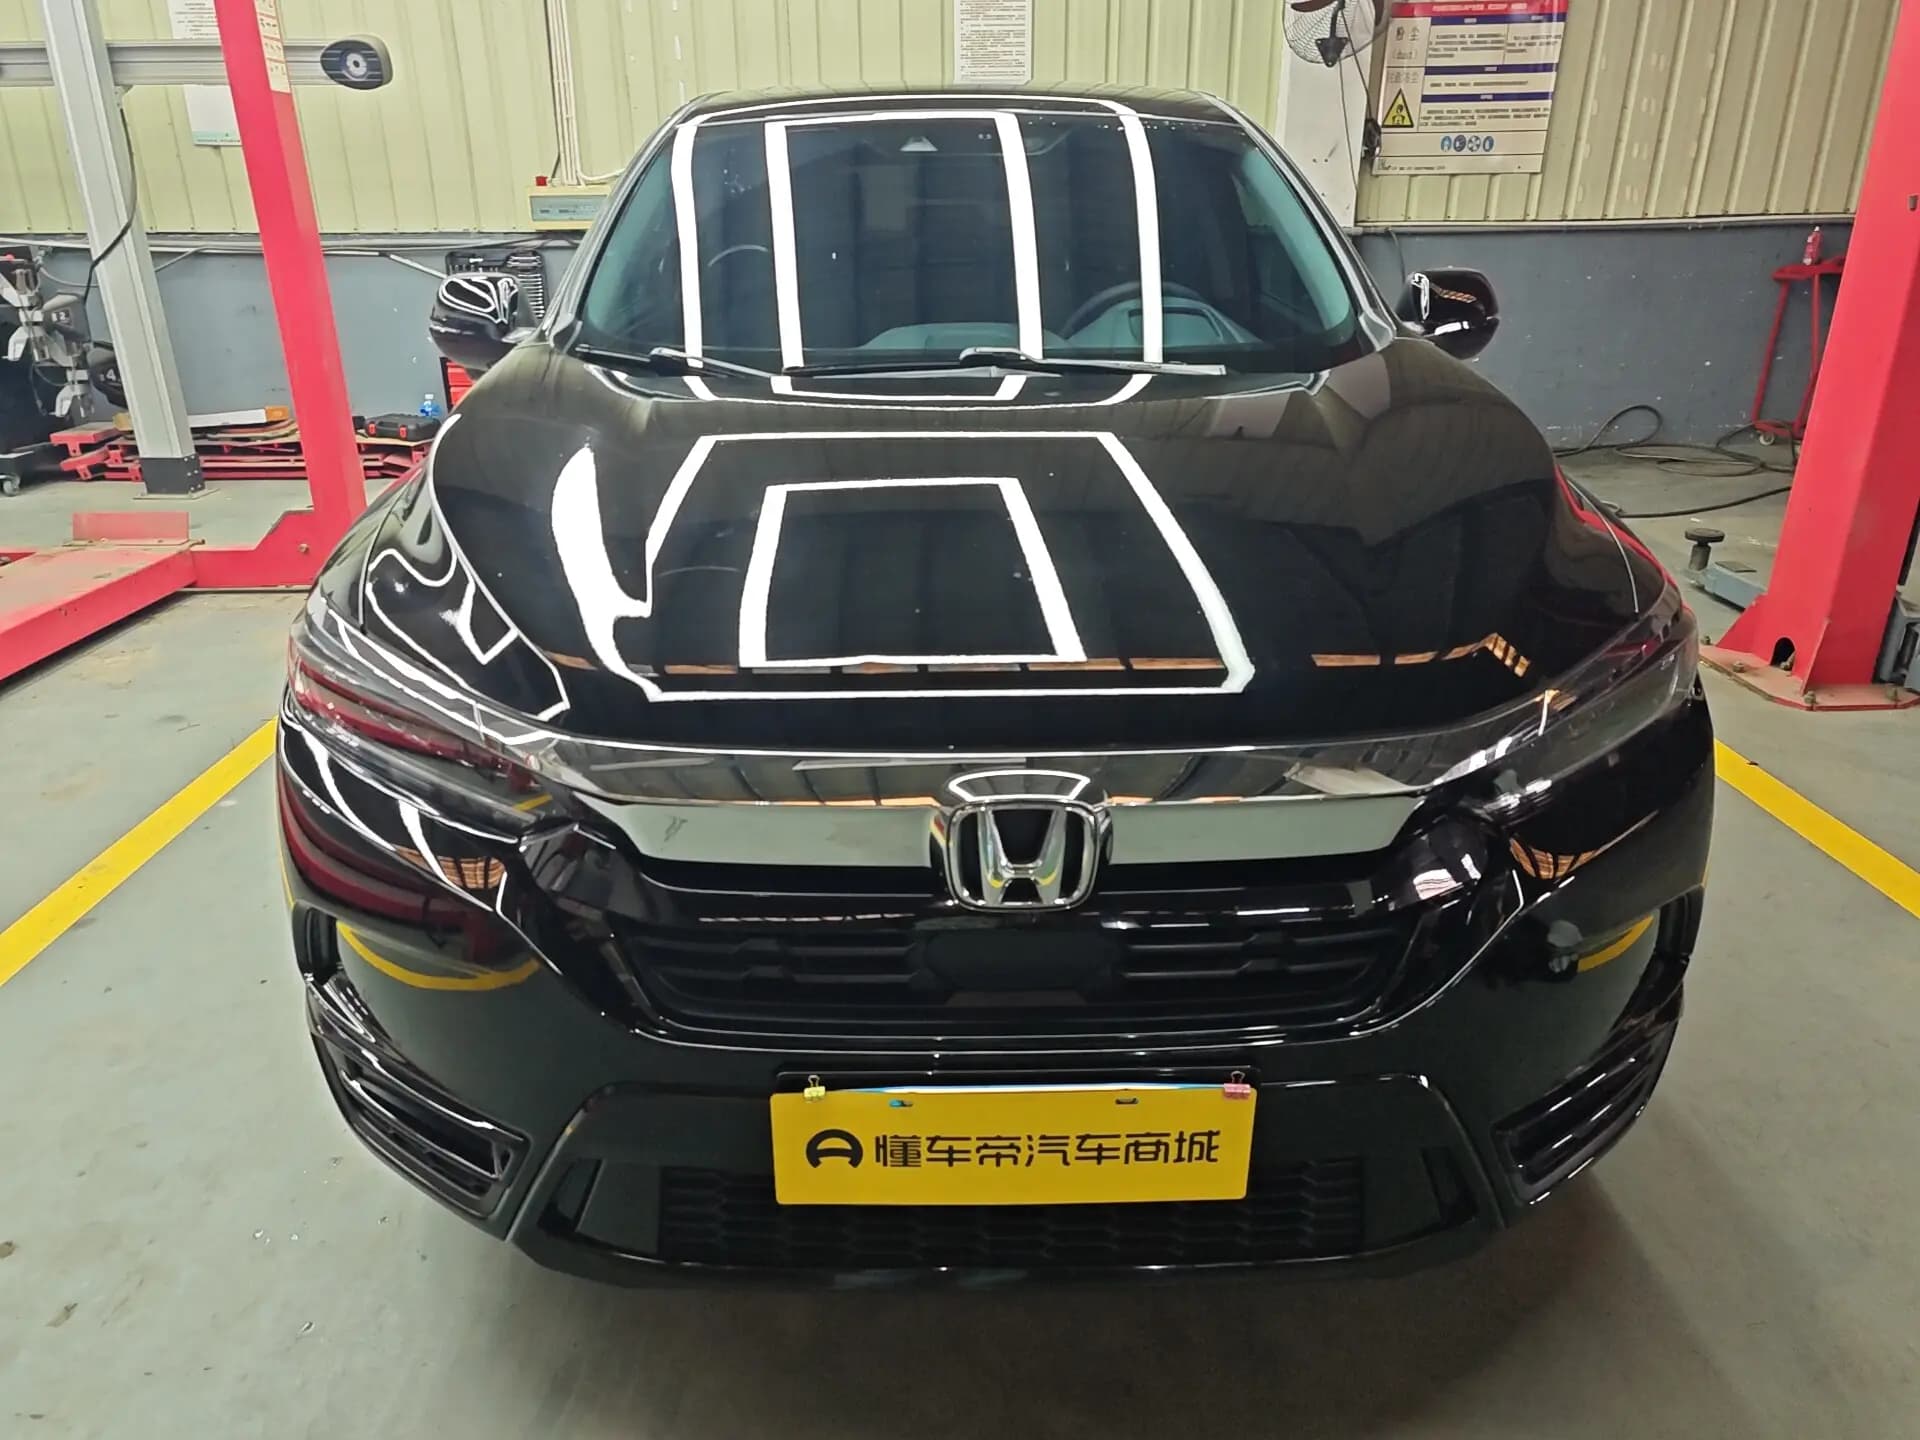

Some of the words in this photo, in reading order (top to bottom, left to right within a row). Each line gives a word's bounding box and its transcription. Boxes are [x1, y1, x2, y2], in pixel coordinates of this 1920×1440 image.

[875, 1130, 1221, 1168] 懂车帝汽车商城
